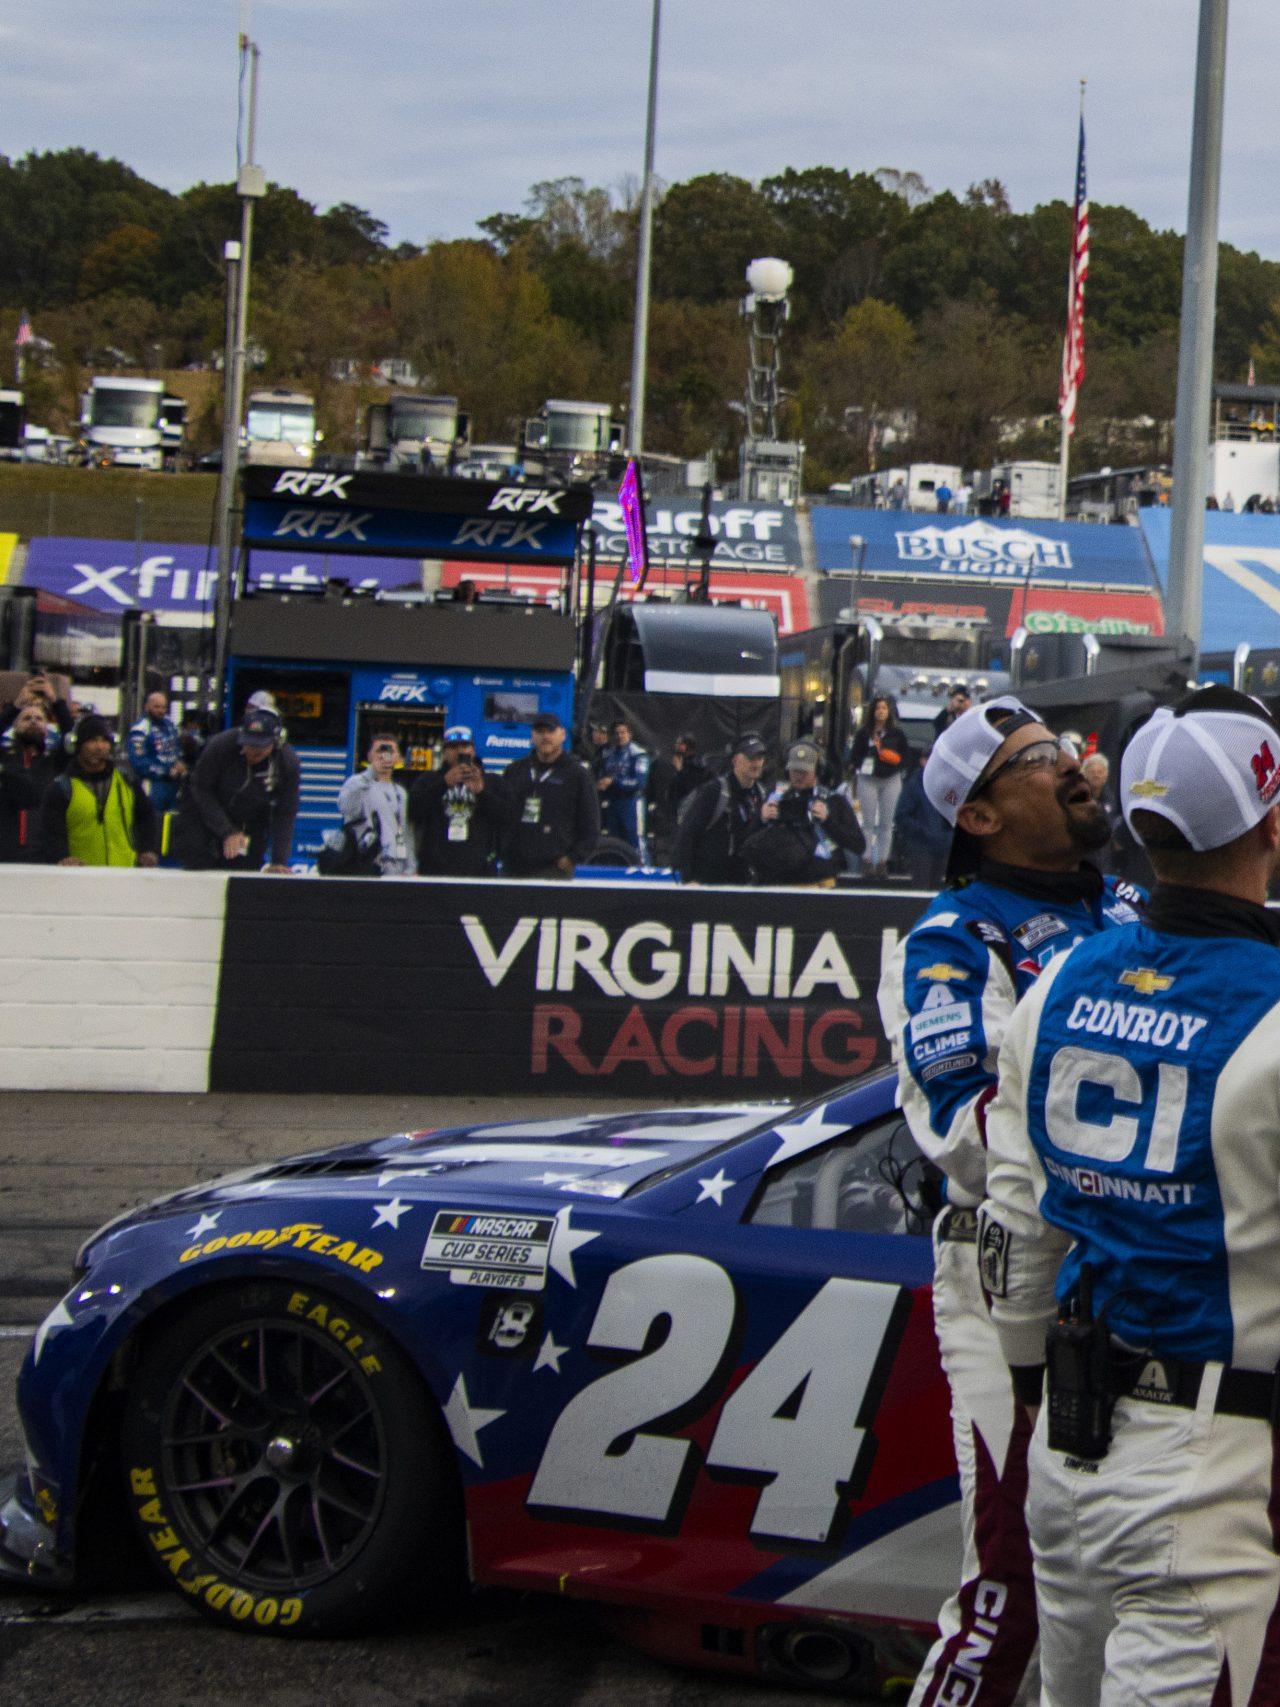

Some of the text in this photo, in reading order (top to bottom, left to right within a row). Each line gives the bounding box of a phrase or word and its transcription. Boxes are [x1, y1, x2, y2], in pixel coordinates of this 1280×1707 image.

[273, 471, 353, 499] RFK
[488, 487, 566, 514] RFK
[273, 510, 373, 541] RFK
[452, 520, 547, 549] RFK
[896, 528, 1073, 568] BUSCH
[940, 559, 1038, 576] LIGHT
[460, 915, 861, 1001] VIRGINIA
[529, 1004, 878, 1079] RACING
[1066, 995, 1208, 1051] CONROY
[913, 1031, 971, 1061] CLIMB
[1045, 1046, 1189, 1173] CI
[1043, 1157, 1196, 1205] CINCINNATI
[469, 1217, 538, 1239] NASCAR
[179, 1223, 385, 1274] GOODYEAR
[441, 1242, 533, 1264] CUP SERIES
[469, 1271, 527, 1288] PLAYOFFS
[287, 1292, 383, 1378] EAGLE
[526, 1253, 904, 1546] 24
[129, 1465, 304, 1627] GOODYEAR
